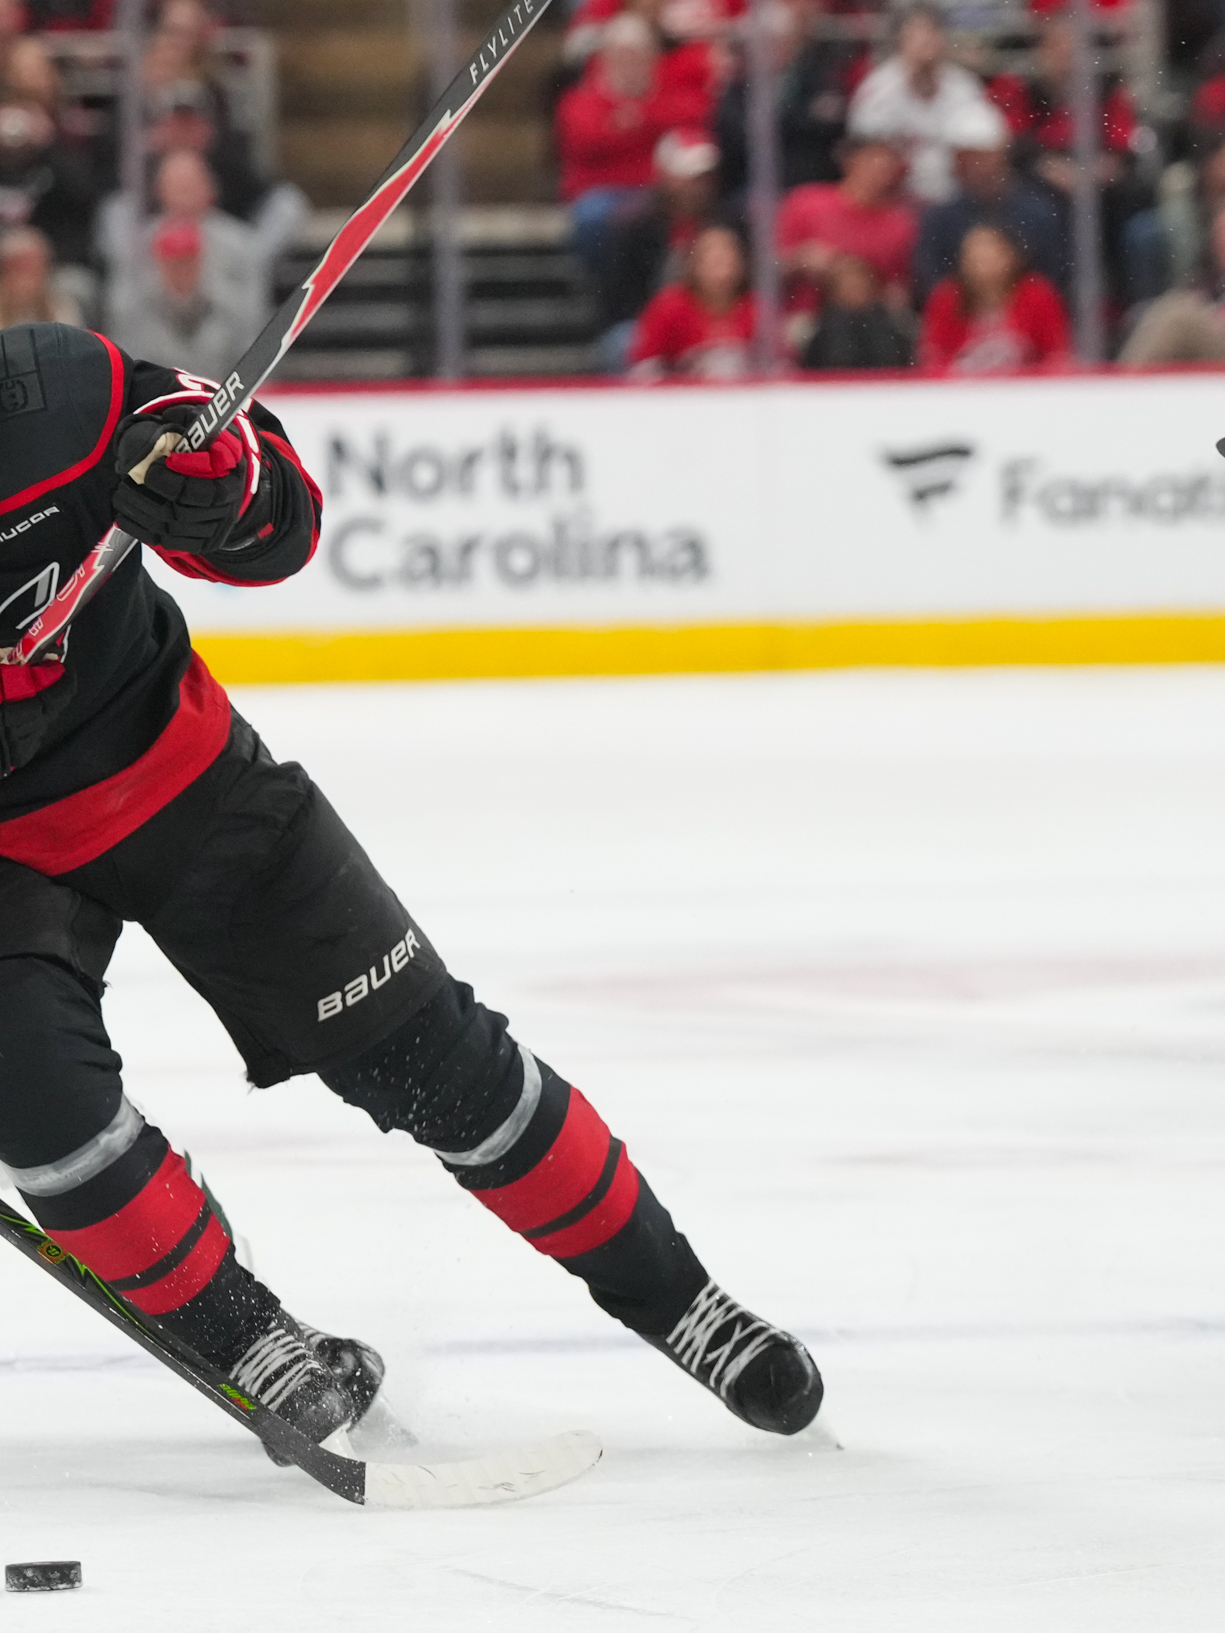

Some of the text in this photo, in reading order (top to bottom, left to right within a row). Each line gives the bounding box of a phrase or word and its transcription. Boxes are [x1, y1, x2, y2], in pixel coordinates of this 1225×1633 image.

[469, 0, 534, 85] FLYLITE
[325, 430, 586, 499] North
[327, 512, 710, 592] Carolina
[317, 928, 421, 1022] BAUER
